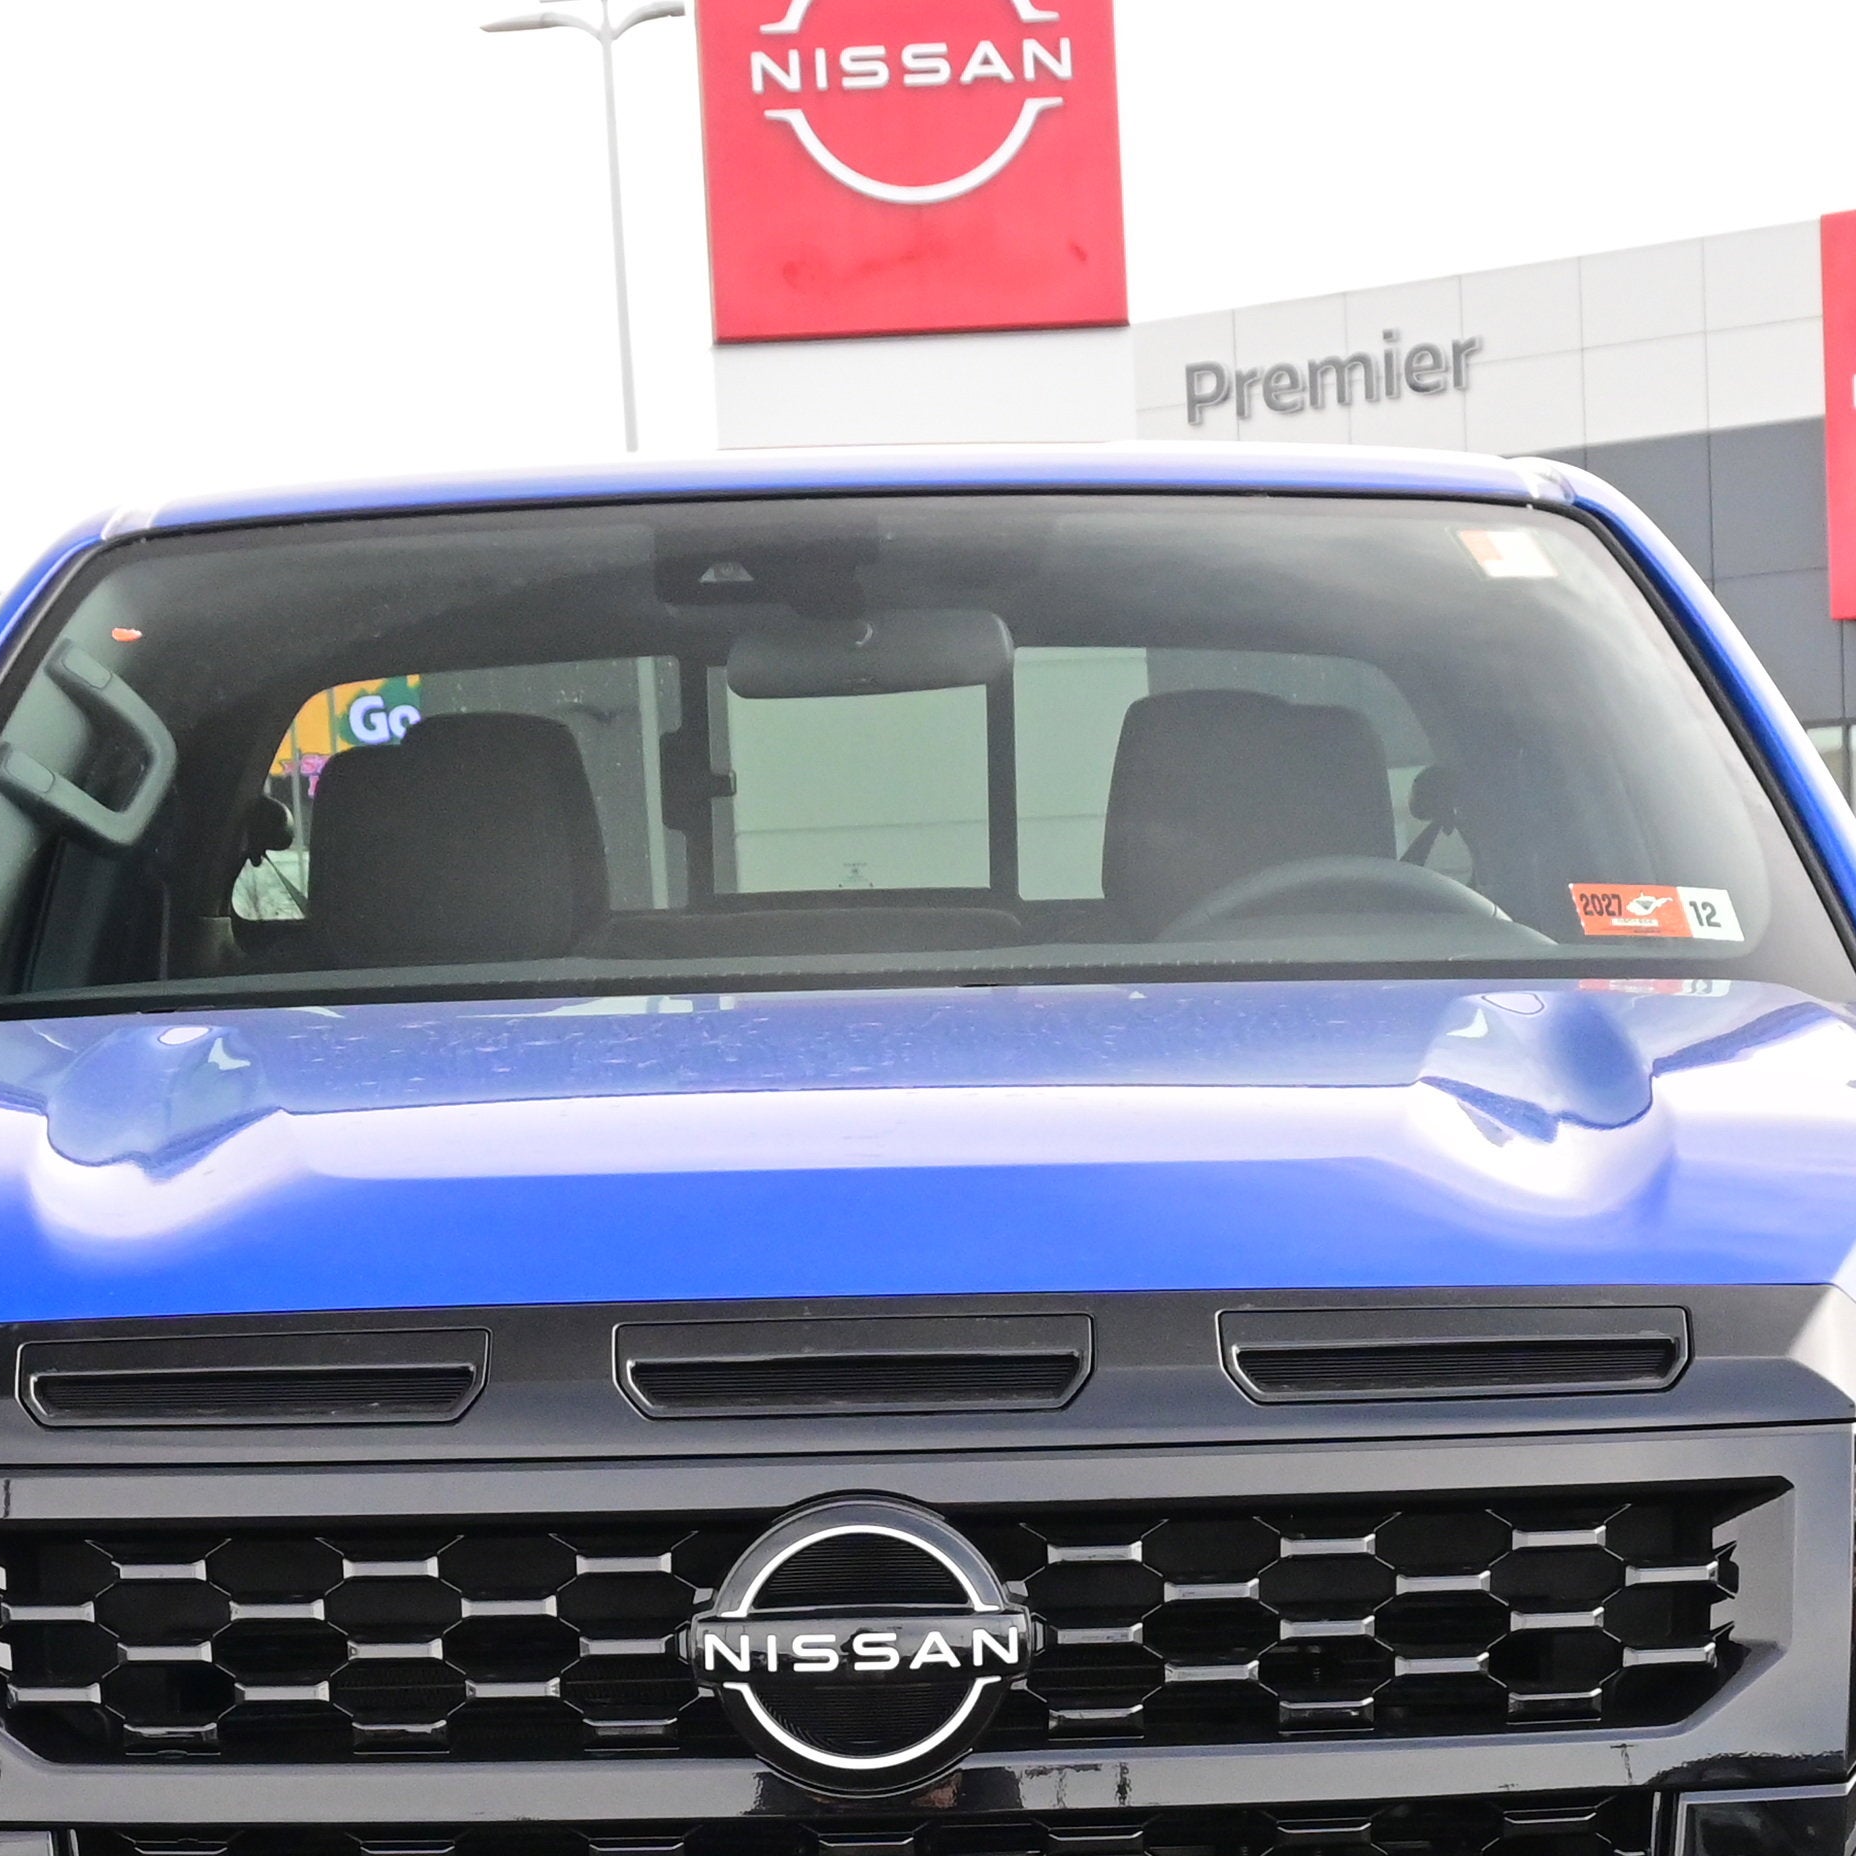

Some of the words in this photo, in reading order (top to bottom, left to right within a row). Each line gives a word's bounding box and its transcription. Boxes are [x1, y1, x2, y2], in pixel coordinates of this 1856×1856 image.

[750, 36, 1073, 95] NISSAN
[1184, 328, 1484, 425] Premier
[1579, 892, 1623, 917] 2027
[1688, 900, 1722, 928] 12
[703, 1625, 1020, 1673] NISSAN
